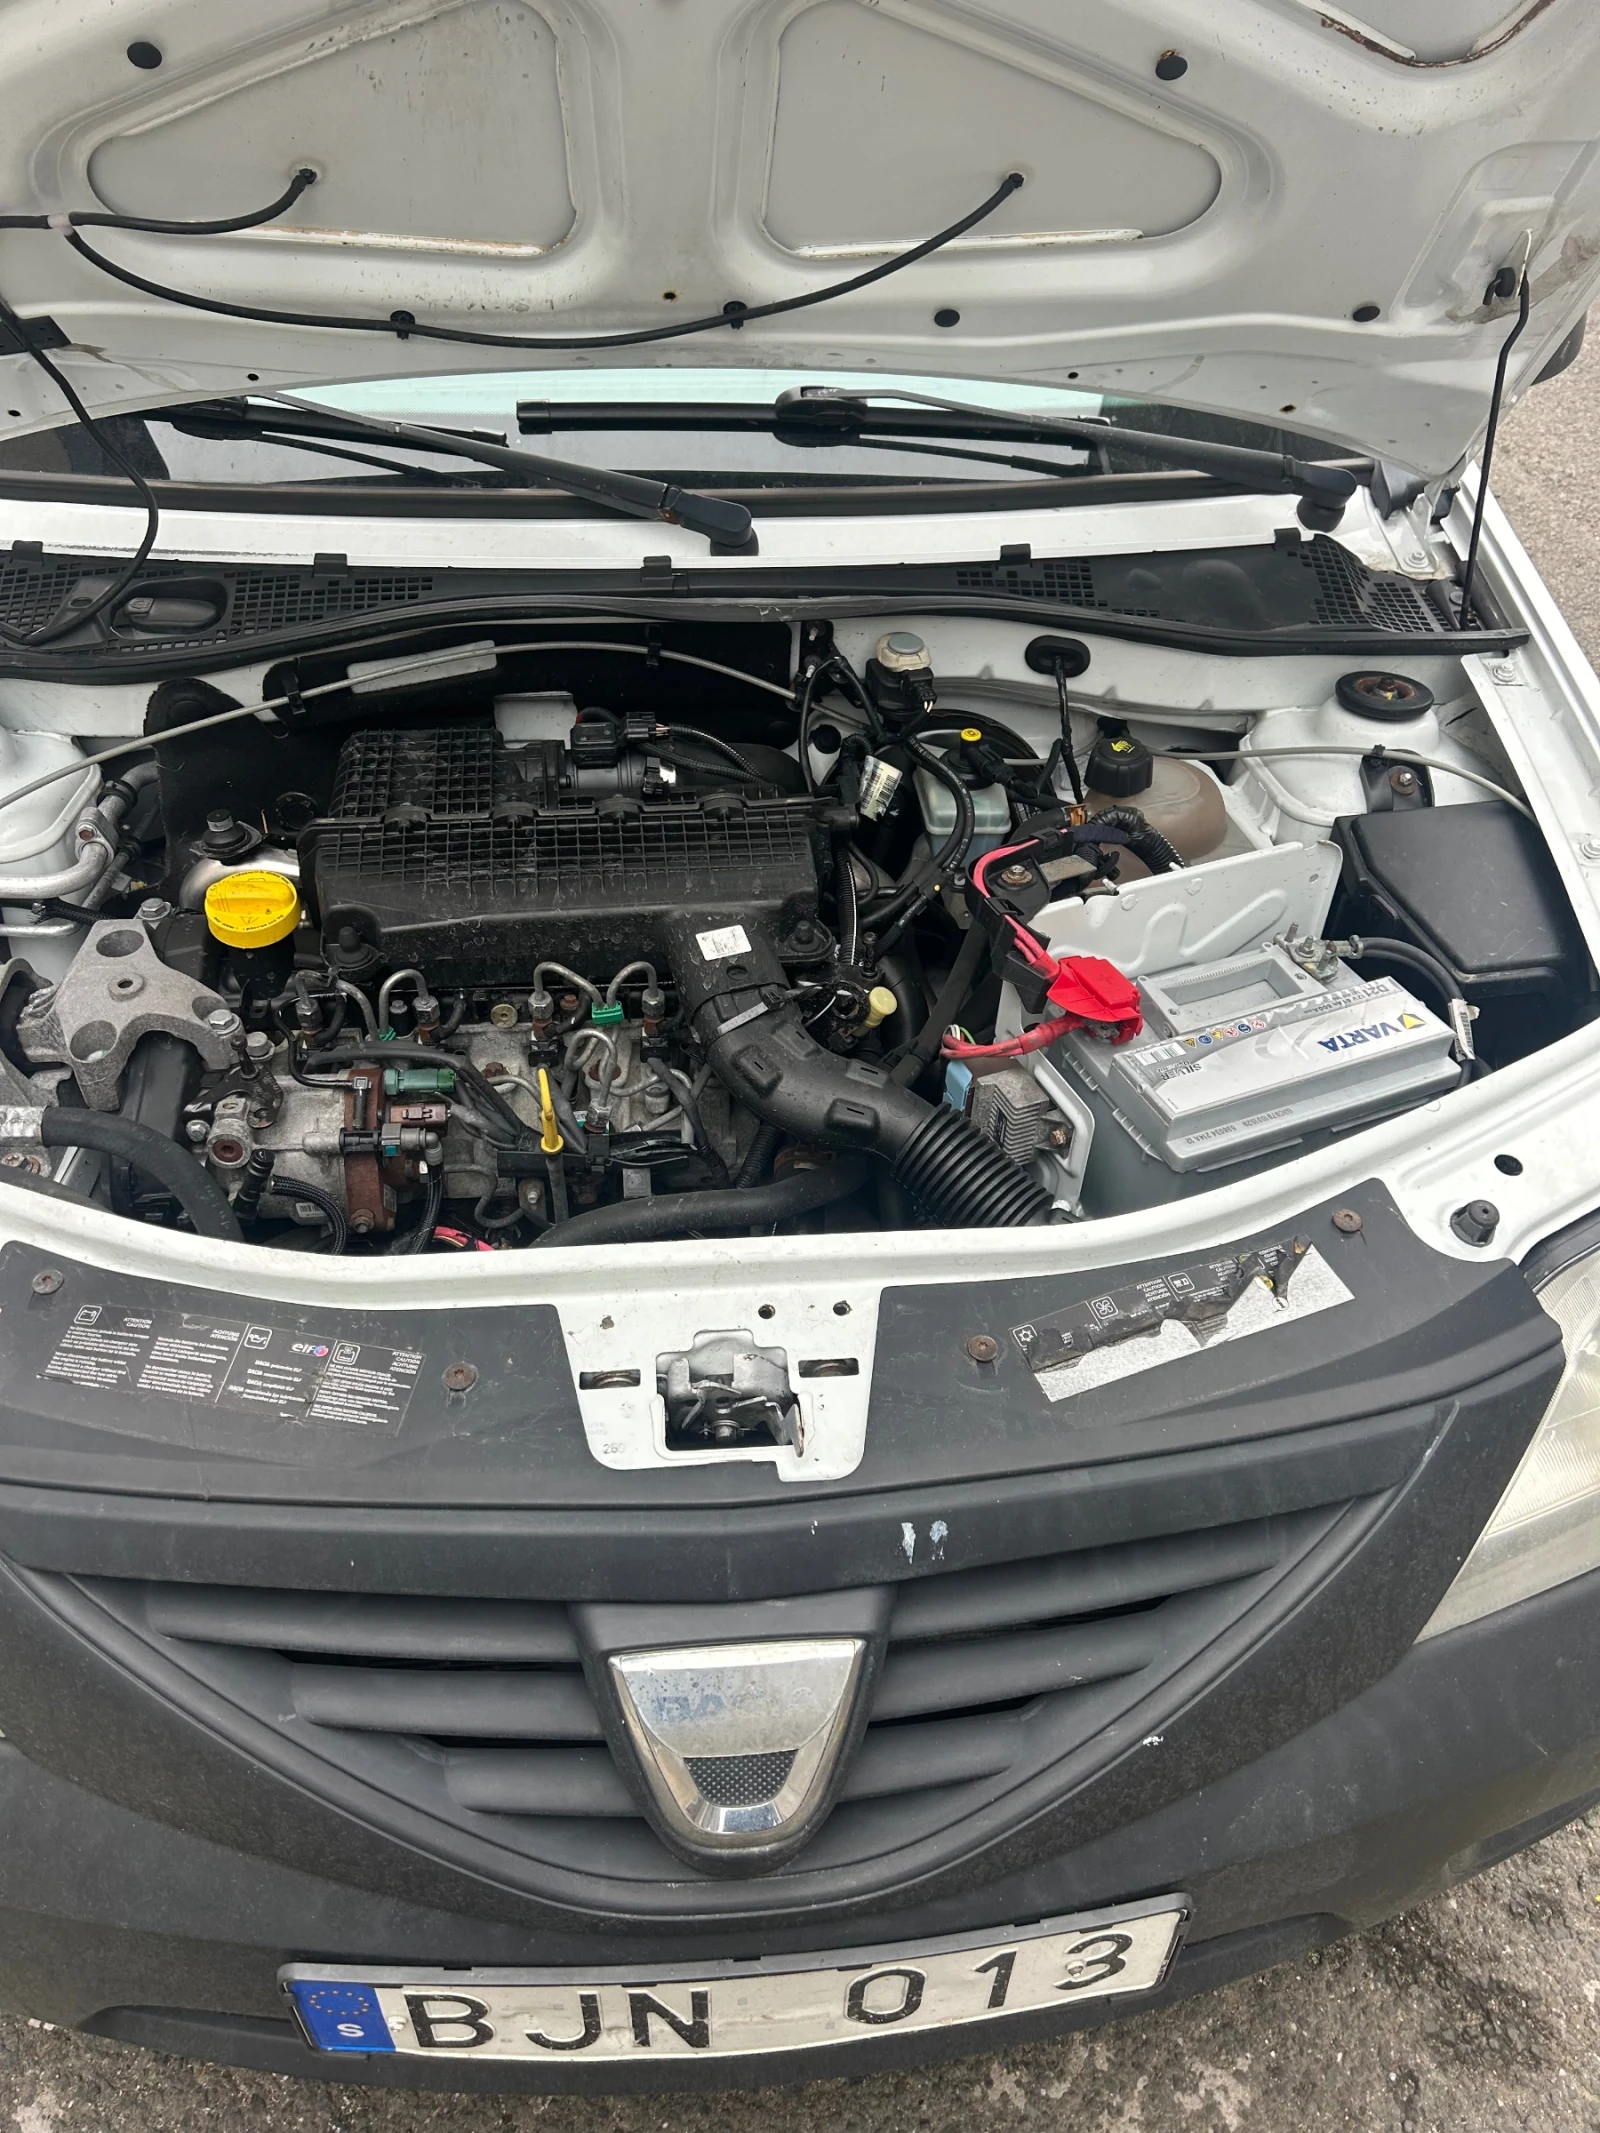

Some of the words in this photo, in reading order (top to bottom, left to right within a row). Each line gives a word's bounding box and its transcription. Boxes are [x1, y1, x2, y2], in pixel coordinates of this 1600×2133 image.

[1317, 1021, 1402, 1052] VARTA
[1160, 1063, 1202, 1080] SILVER
[1136, 1279, 1162, 1290] ATTENTION
[1143, 1283, 1165, 1293] CAUTION
[391, 1351, 422, 1360] ATTENTION
[395, 1357, 420, 1365] CAUTION
[391, 1361, 419, 1370] ACHTUNG
[403, 1988, 712, 2050] BJN
[846, 1930, 1133, 2025] 013
[336, 2022, 365, 2038] S
